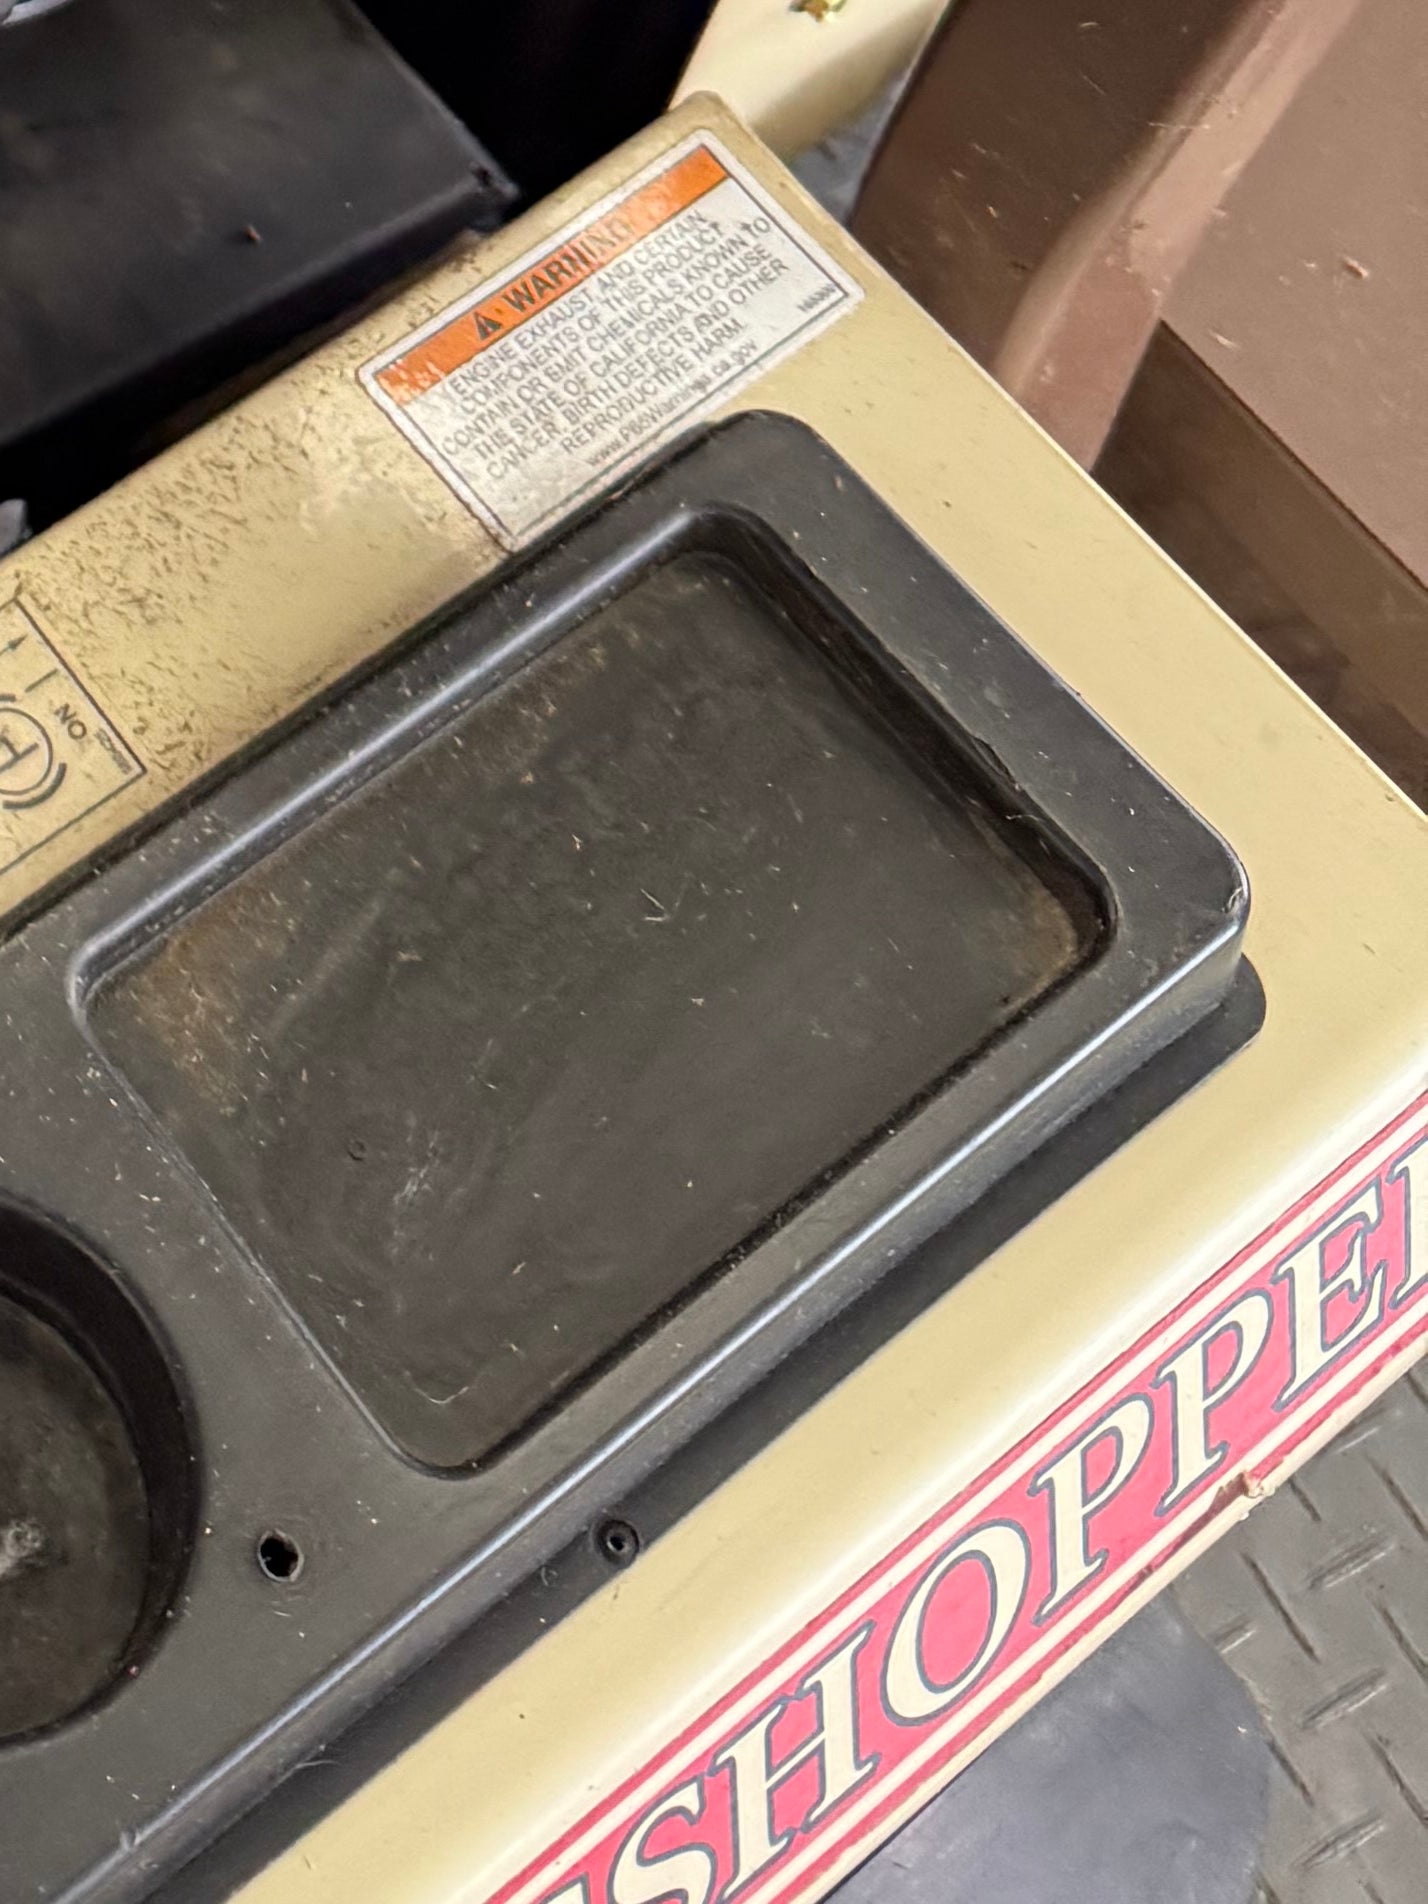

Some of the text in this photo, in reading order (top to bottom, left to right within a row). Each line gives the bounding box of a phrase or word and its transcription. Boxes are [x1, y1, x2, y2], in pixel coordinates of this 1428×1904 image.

[438, 209, 772, 459] CONTAIN OR EMIT CHEMICALS KNOWN TO
[446, 339, 518, 399] ENGINE
[594, 255, 636, 293] AND
[630, 205, 708, 269] CERTAIN
[456, 218, 726, 418] COMPONENTS OF THIS PRODUCT
[472, 238, 773, 462] THE STATE OF CALIFORNIA TO CAUSE
[499, 213, 637, 319] WARNING
[561, 376, 619, 428] BIRTH
[613, 321, 696, 390] DEFECTS
[691, 295, 732, 335] AND
[725, 253, 791, 309] OTHER
[558, 349, 695, 456] REPRODUCTIVE
[53, 703, 88, 741] ON
